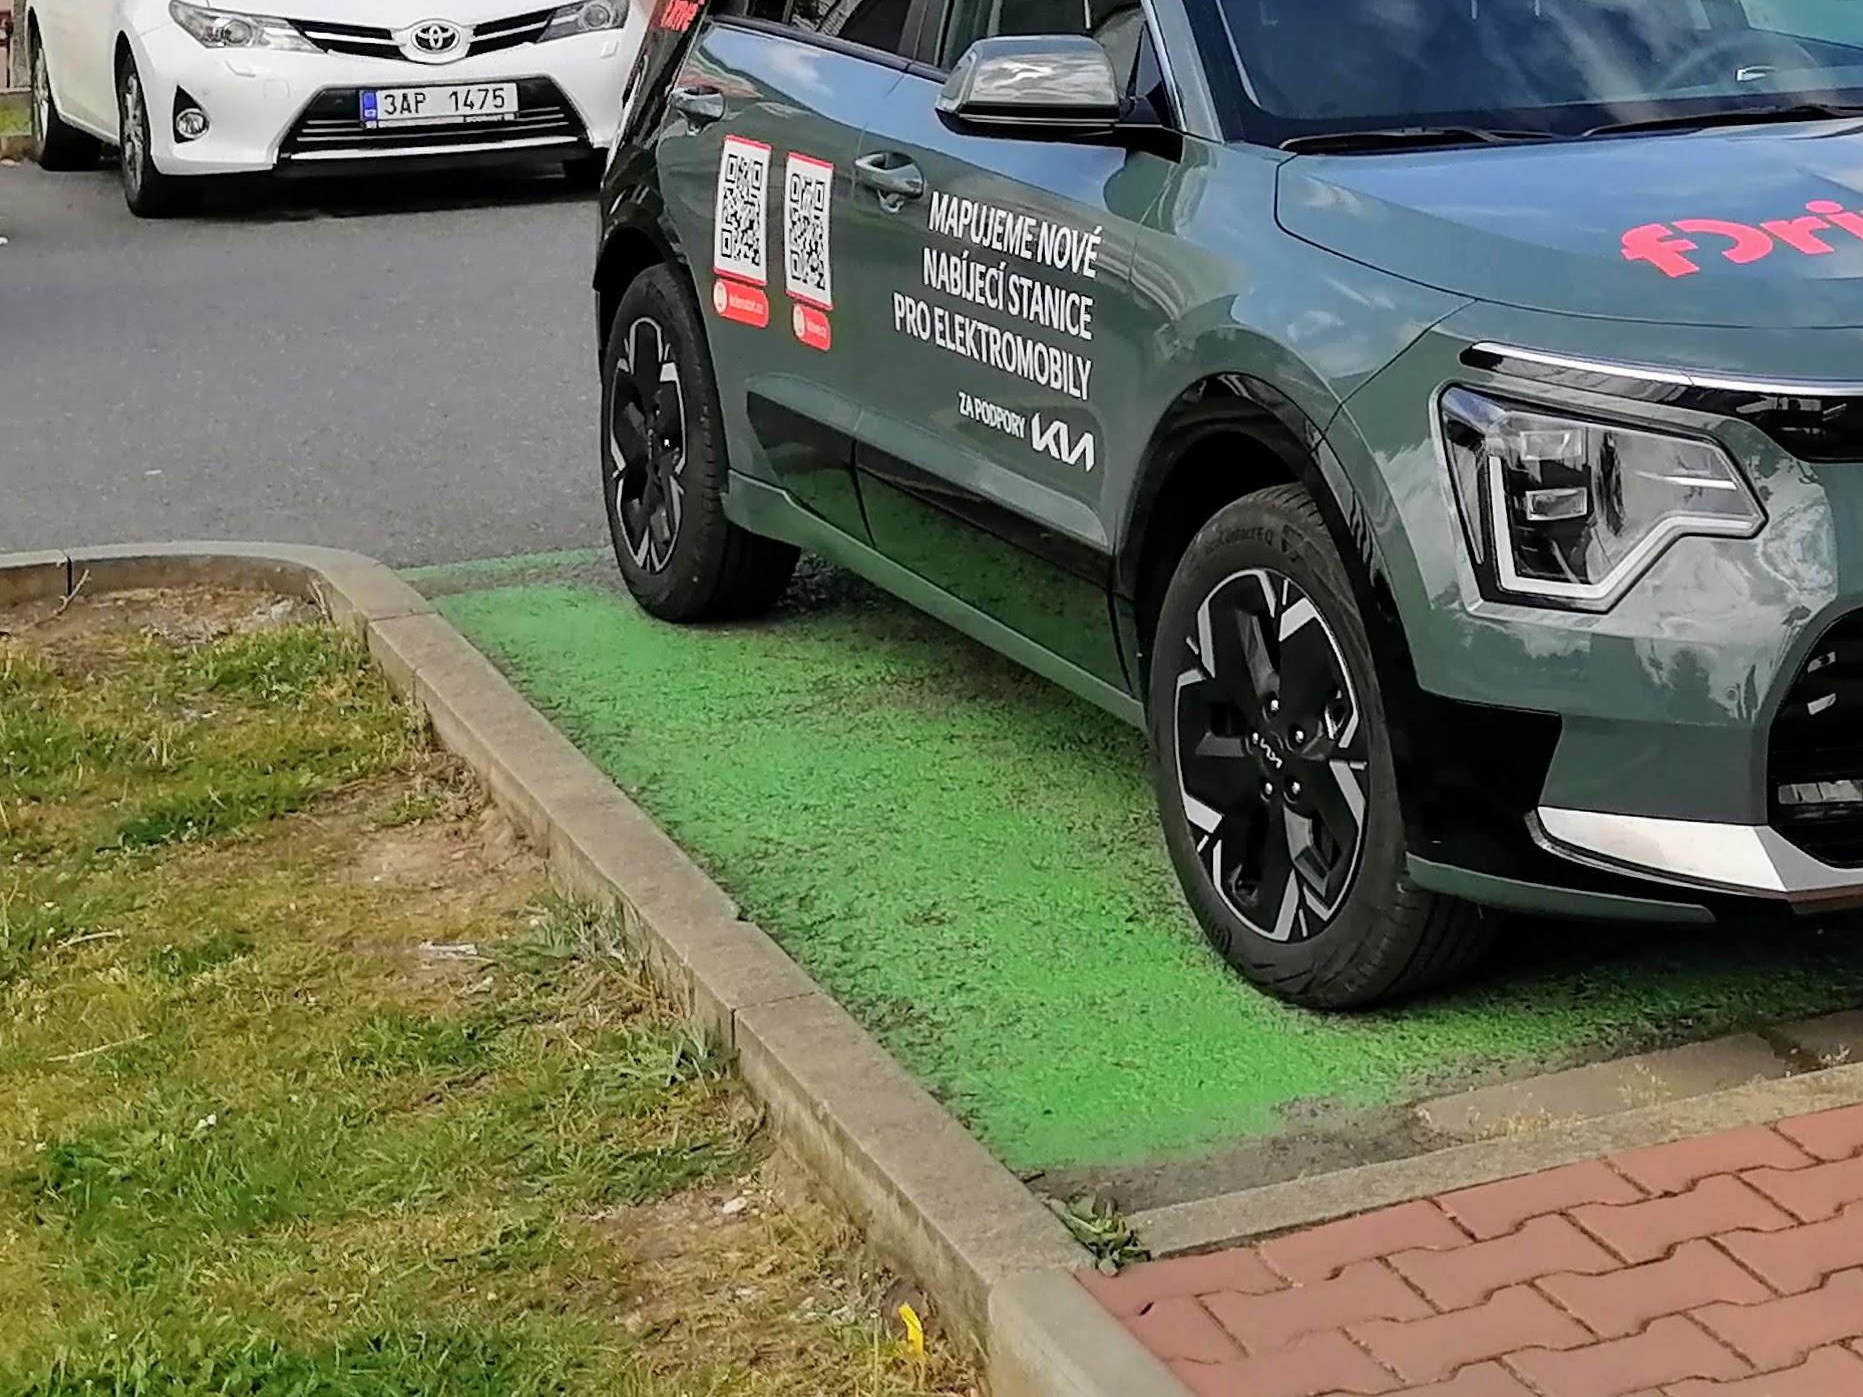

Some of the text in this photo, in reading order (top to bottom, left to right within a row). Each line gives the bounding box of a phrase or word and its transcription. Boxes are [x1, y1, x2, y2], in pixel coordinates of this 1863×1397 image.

[384, 88, 505, 115] 3AP 1475
[929, 191, 1102, 279] MAPUJEME NOVÉ
[923, 247, 1094, 340] NABÍJECÍ STANICE
[893, 292, 1093, 401] PRO ELEKTROMOBILY
[958, 392, 974, 418] ZA
[974, 397, 1028, 440] PODPORY
